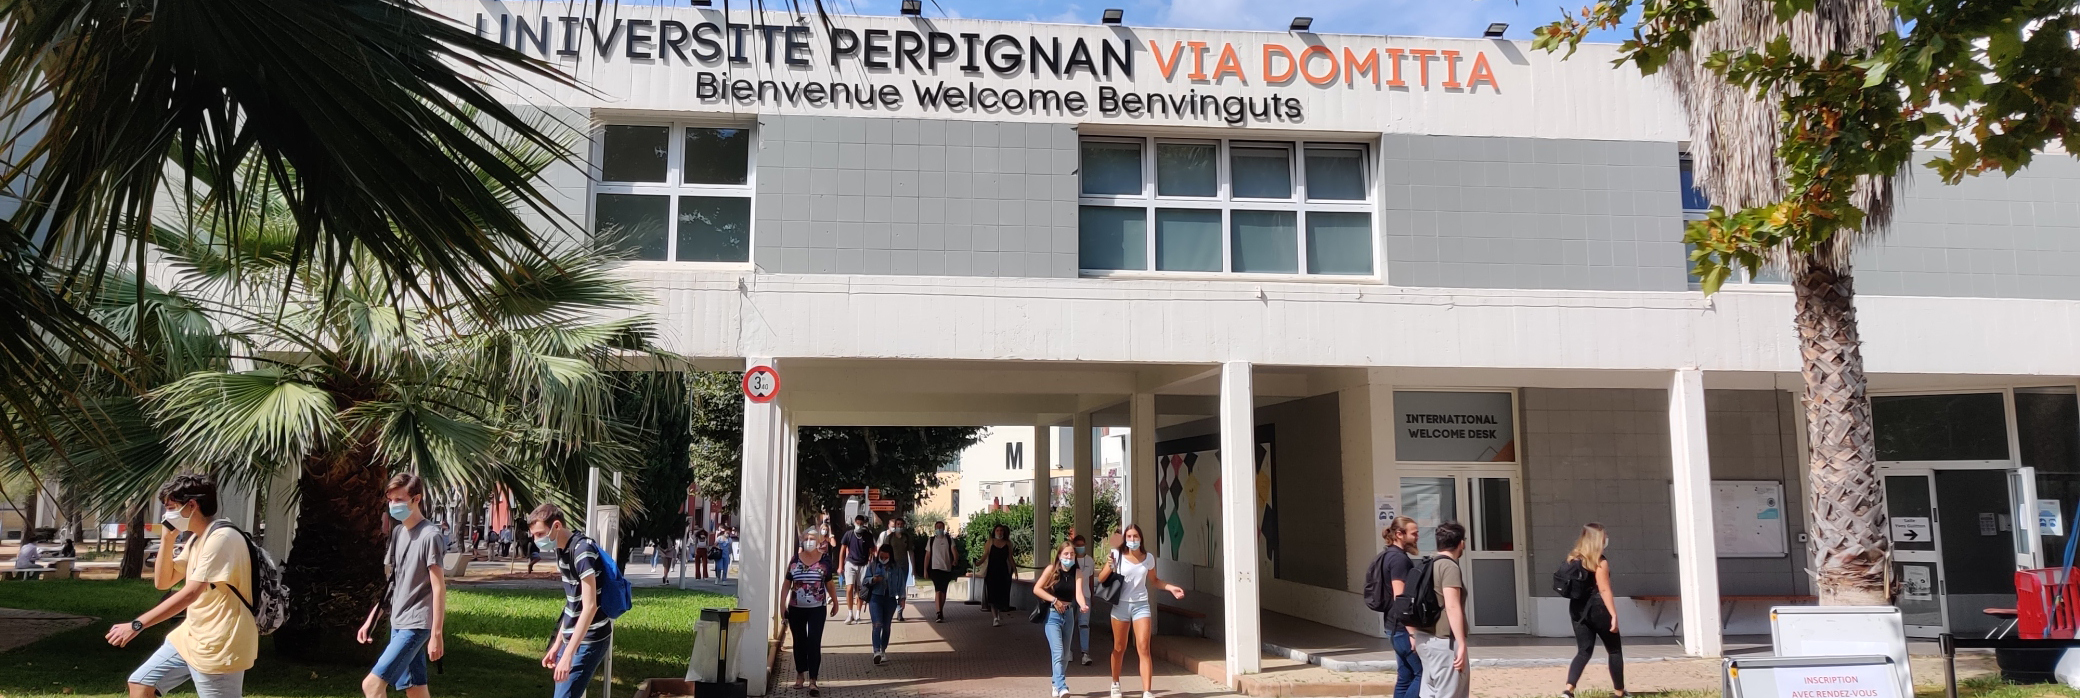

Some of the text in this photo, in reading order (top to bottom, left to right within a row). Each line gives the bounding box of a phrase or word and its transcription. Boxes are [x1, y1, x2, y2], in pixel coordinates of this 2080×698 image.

[830, 28, 1131, 77] PERPIGNAN
[1149, 39, 1245, 82] VIA
[1262, 43, 1499, 90] DOMITIA
[696, 71, 1302, 123] Bienvenue Welcome Benvinguts
[754, 376, 761, 390] 3
[1405, 413, 1498, 425] INTERNATIONAL
[1408, 428, 1497, 440] WELCOME DESK
[1005, 441, 1023, 470] M
[1803, 676, 1859, 685] INSCRIPTION
[1792, 689, 1878, 698] AVEC RENDEZ-VOUS
